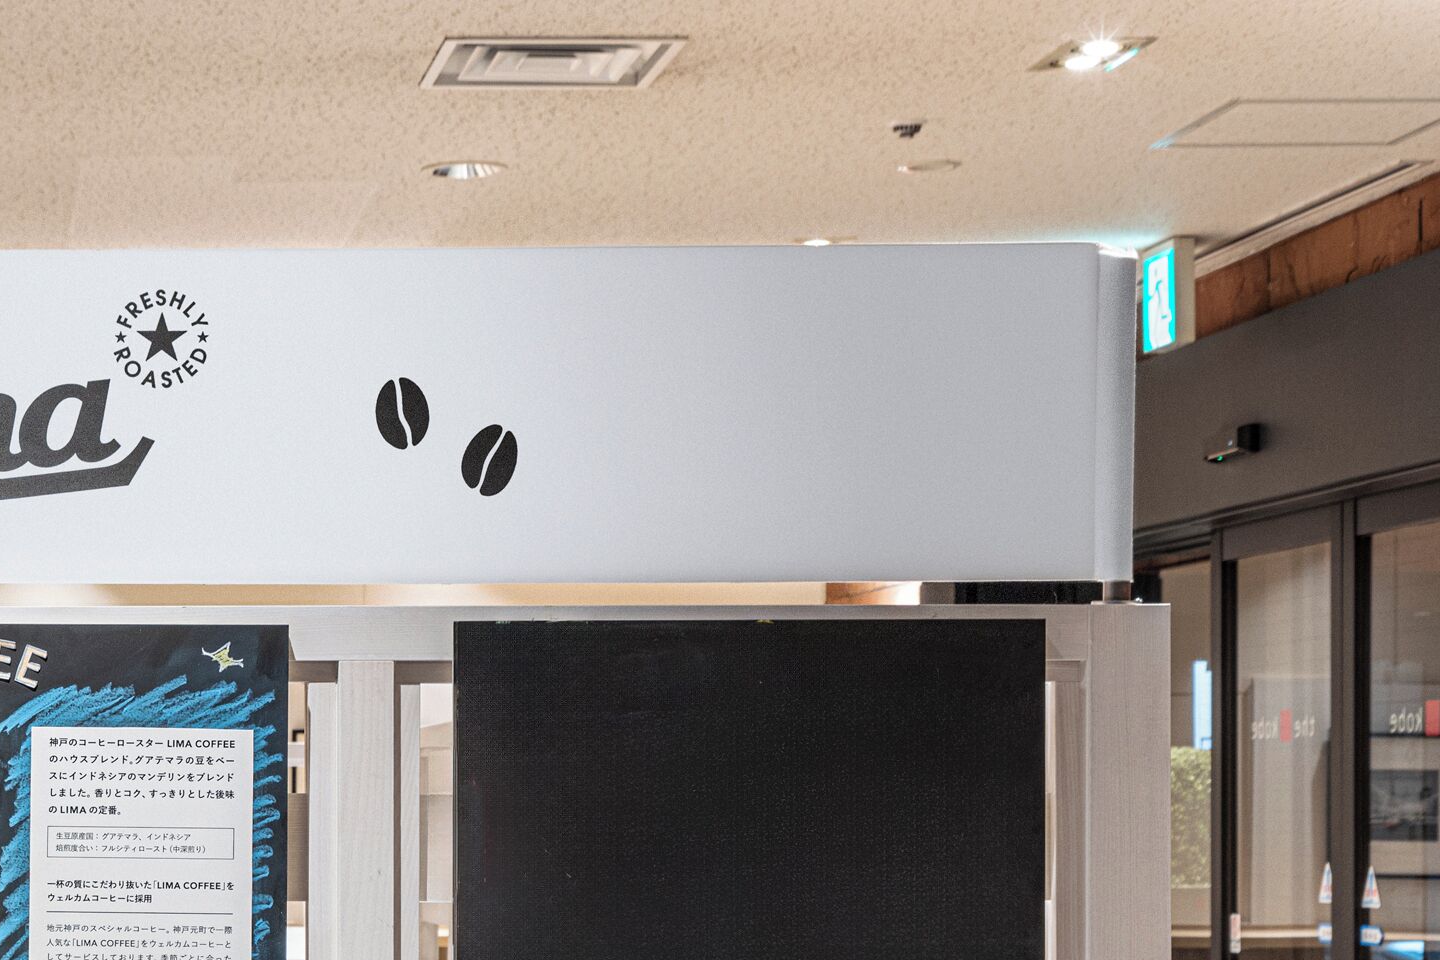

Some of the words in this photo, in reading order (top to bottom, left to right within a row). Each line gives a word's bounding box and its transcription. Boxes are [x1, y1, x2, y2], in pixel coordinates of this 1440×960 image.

[116, 289, 209, 329] FRESHLY
[113, 346, 207, 389] ROASTED
[49, 737, 163, 748] 神戸のコーヒーロースター
[167, 739, 192, 748] LIMA
[195, 739, 236, 748] COFFEE
[49, 771, 234, 782] スにインドネシアのマンデリンをブレンド
[60, 806, 87, 814] LIMA
[89, 805, 122, 815] の定番。
[47, 894, 153, 904] ウェルカムコーヒーに採用
